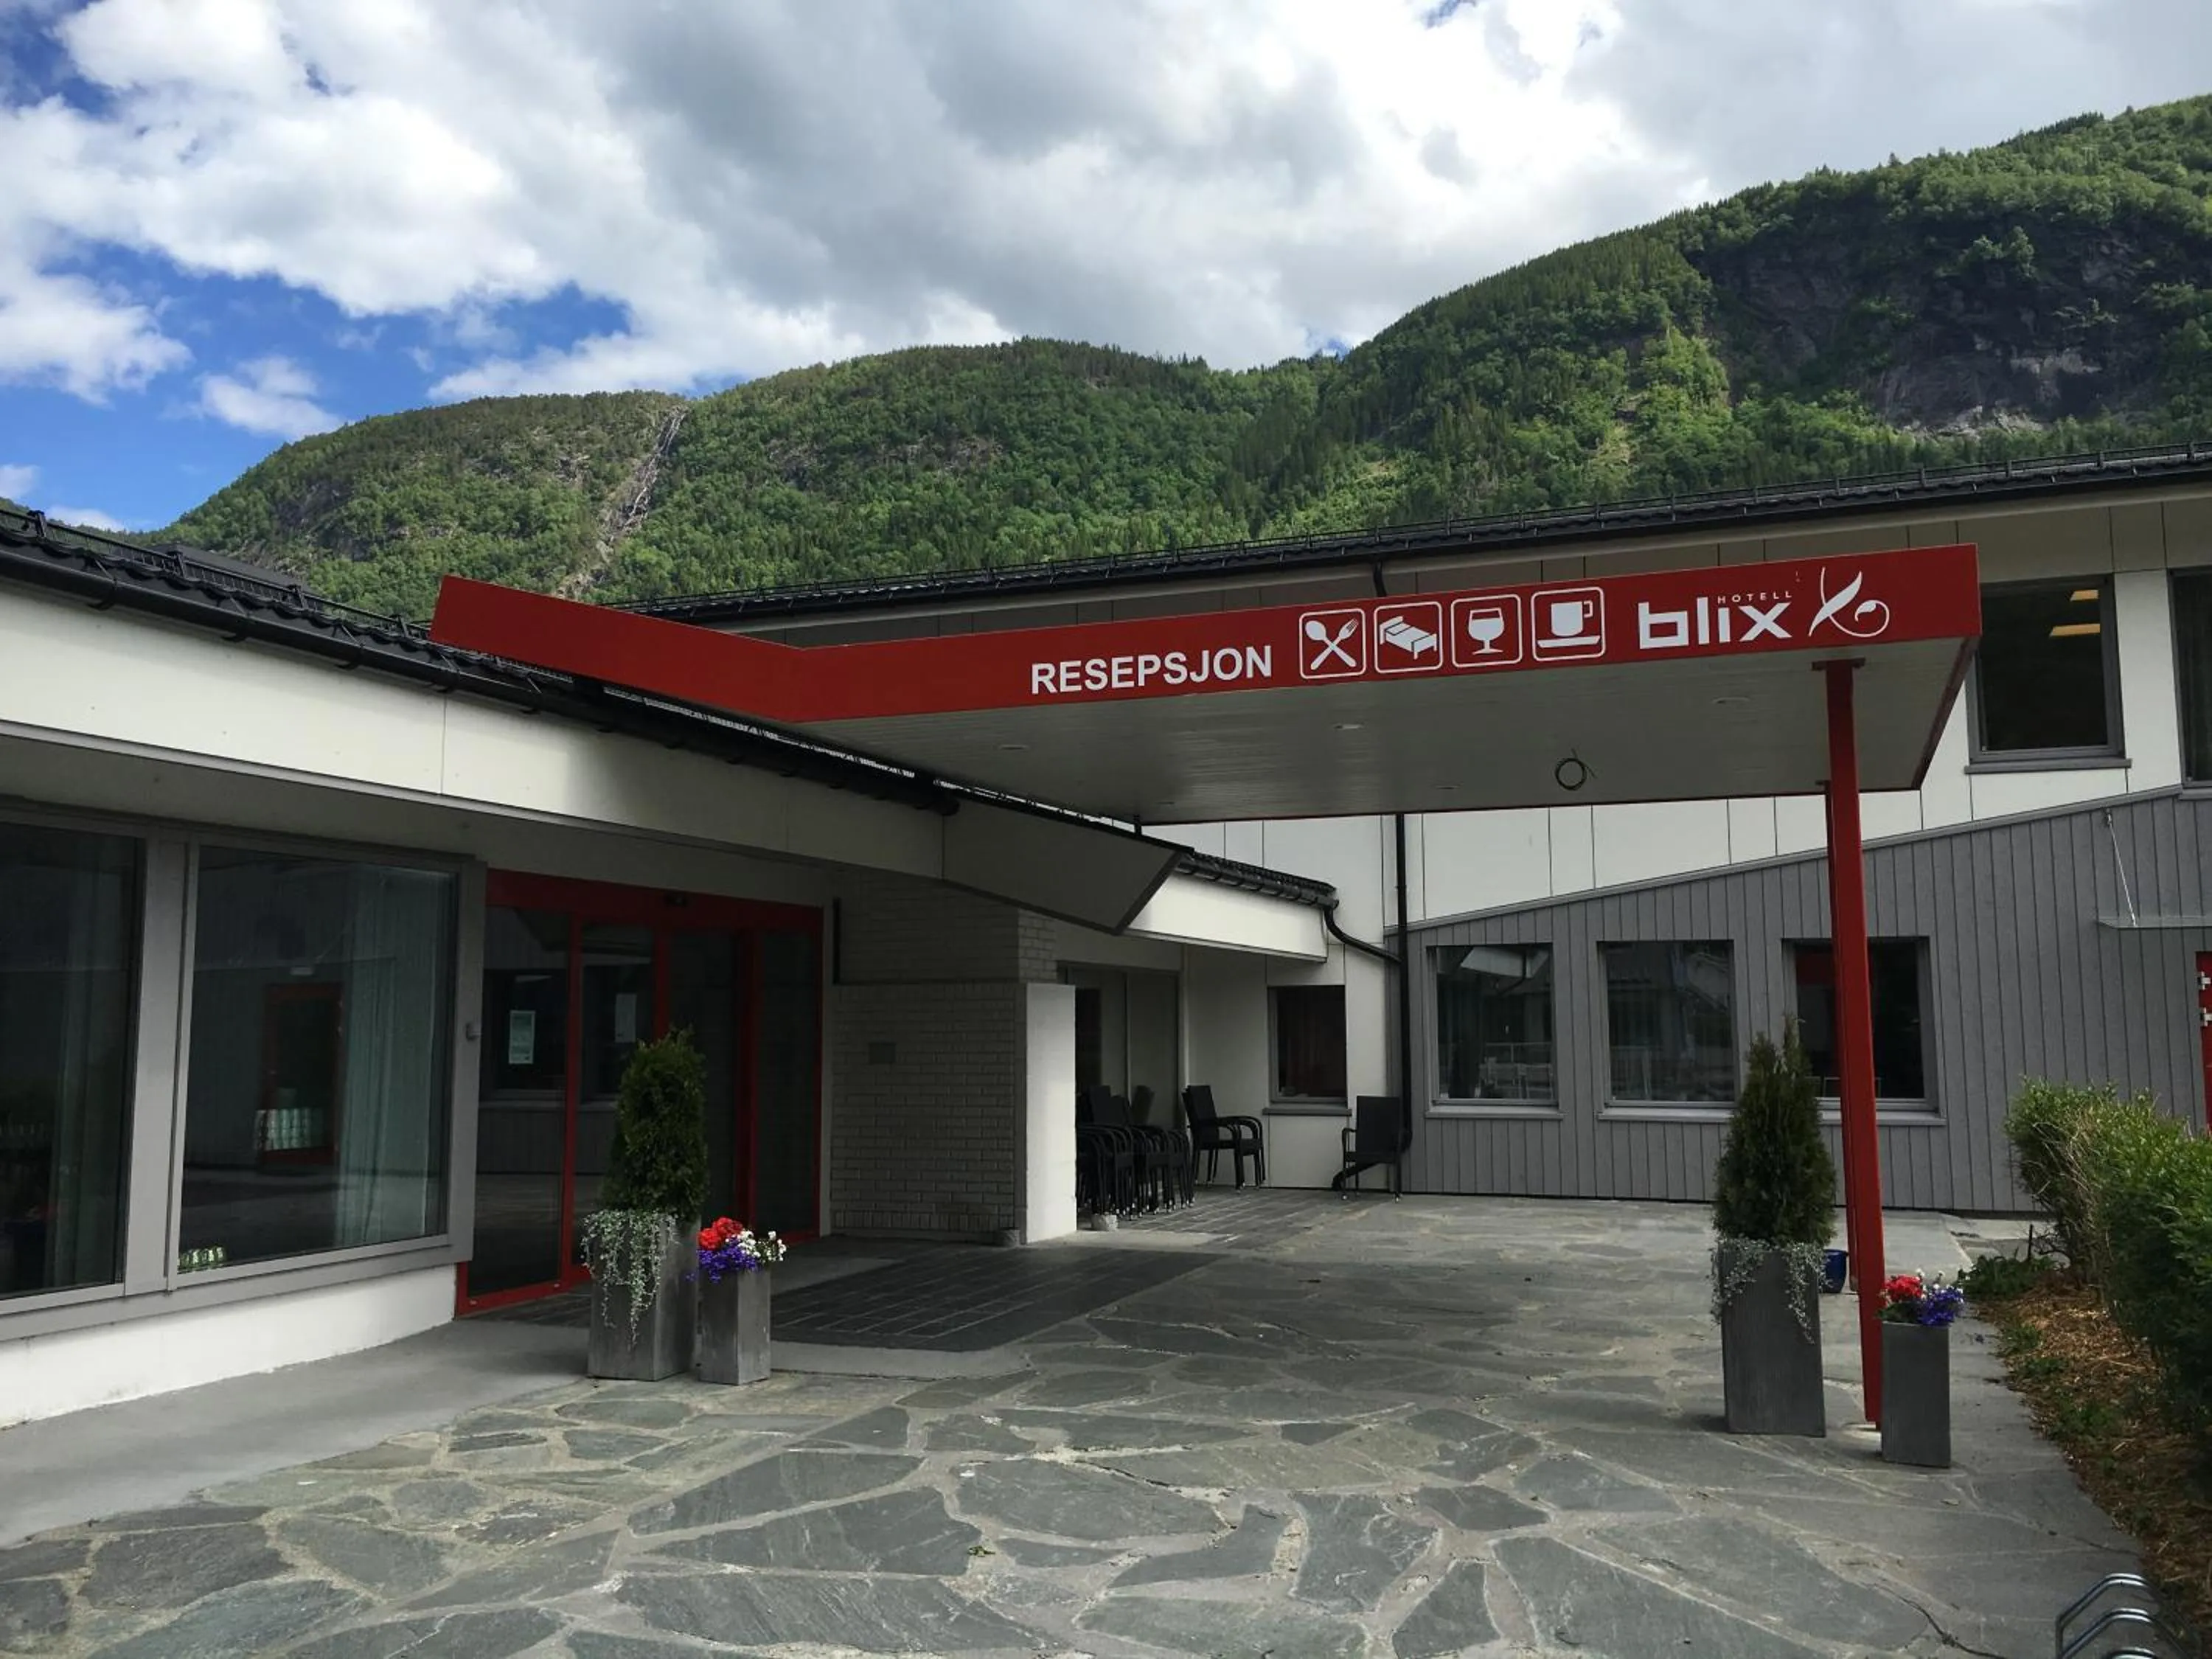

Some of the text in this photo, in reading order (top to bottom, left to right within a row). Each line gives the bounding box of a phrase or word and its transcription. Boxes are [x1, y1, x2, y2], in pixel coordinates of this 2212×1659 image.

[1717, 591, 1792, 604] HOTELL
[1638, 597, 1792, 650] blix
[1031, 645, 1273, 695] RESEPSJON
